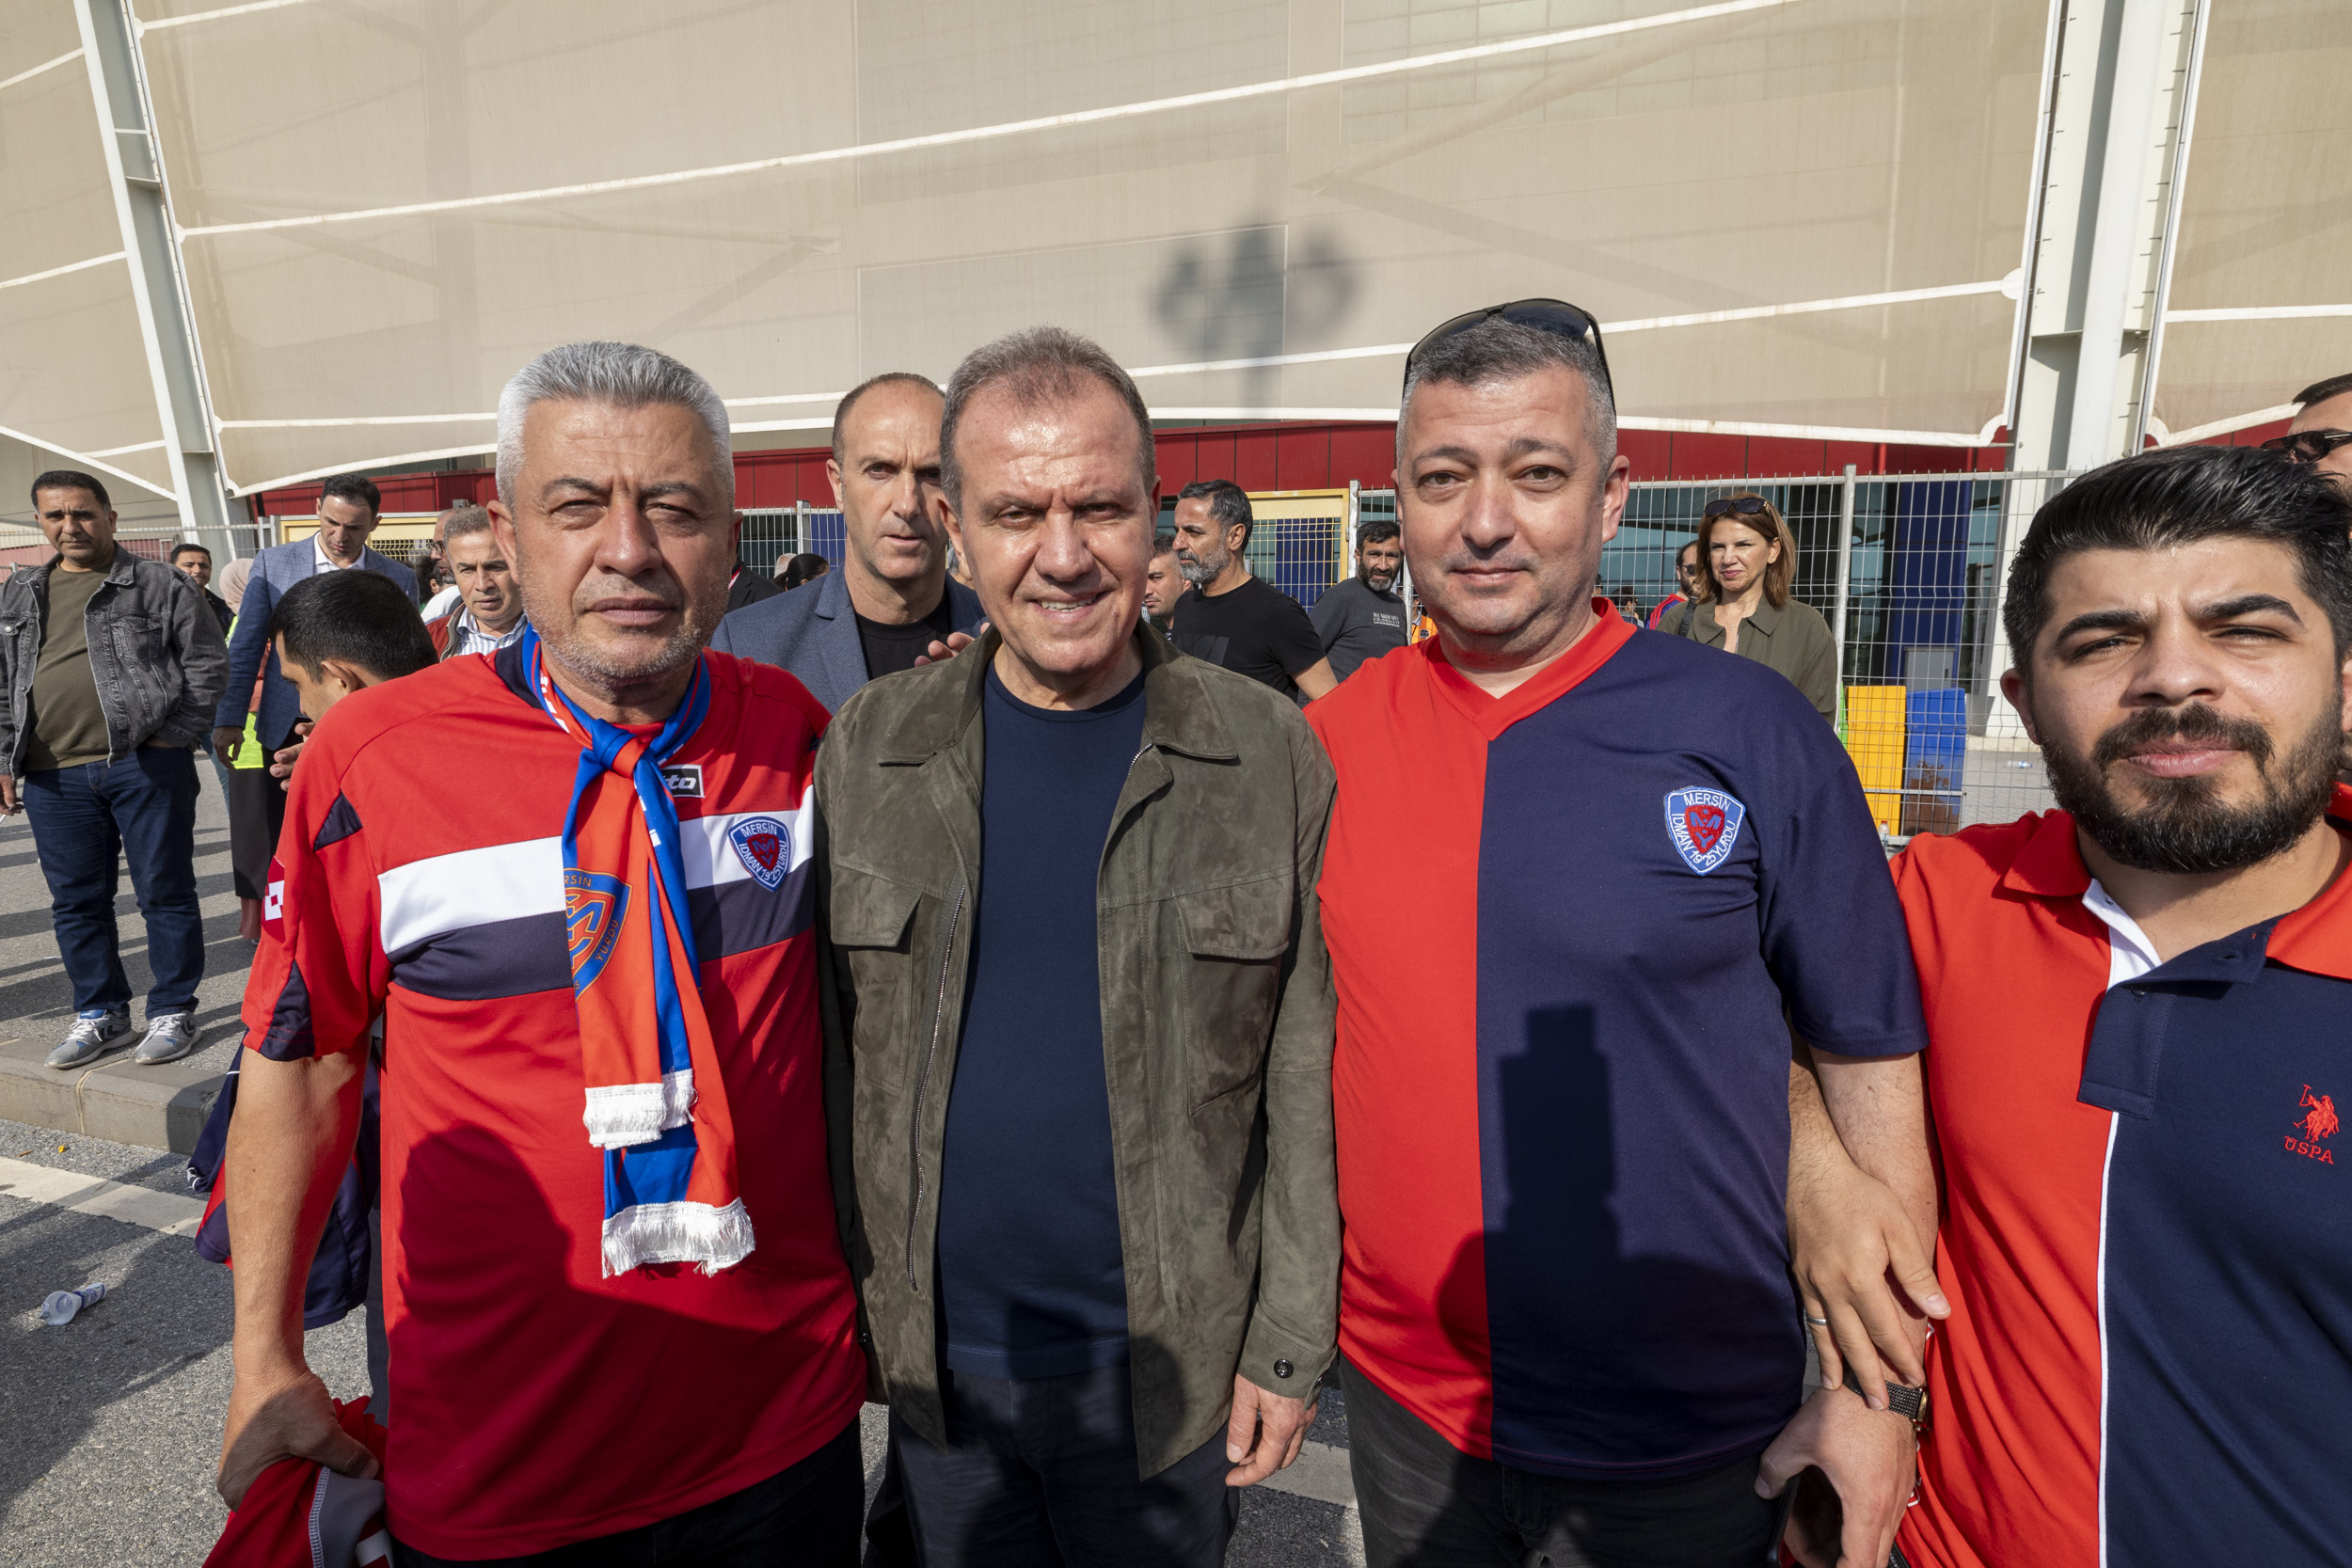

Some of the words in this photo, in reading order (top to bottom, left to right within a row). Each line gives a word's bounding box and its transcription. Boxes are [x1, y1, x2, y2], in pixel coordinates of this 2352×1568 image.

[663, 774, 696, 789] to
[1690, 850, 1716, 866] 1925
[1712, 819, 1736, 858] YURDU
[760, 868, 781, 881] 1925
[775, 840, 787, 870] YURDU
[564, 873, 592, 887] RSİN
[595, 920, 619, 962] YURDU
[2284, 1135, 2334, 1164] USPA
